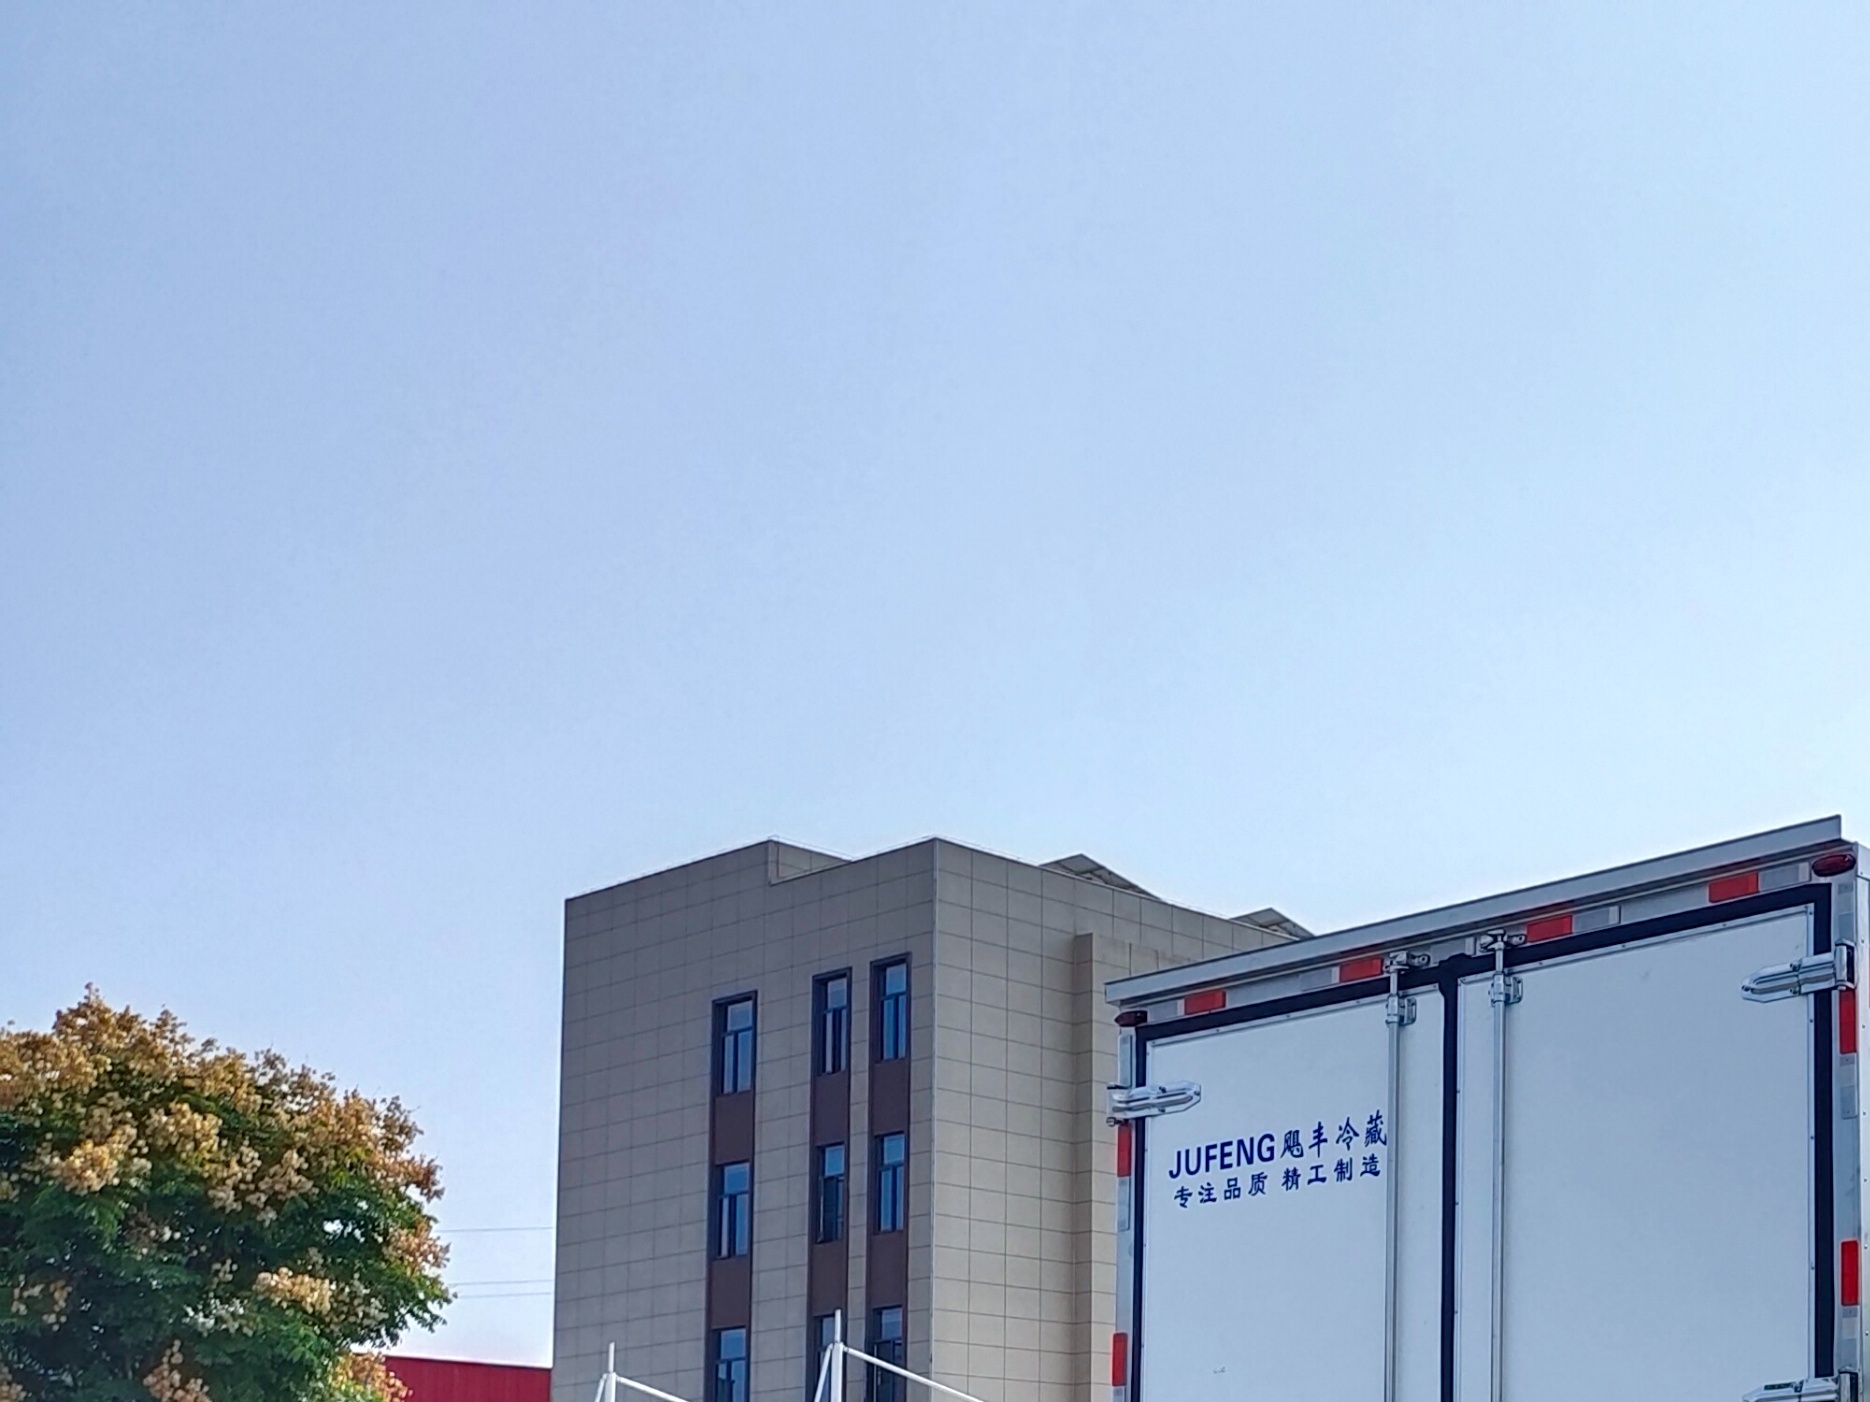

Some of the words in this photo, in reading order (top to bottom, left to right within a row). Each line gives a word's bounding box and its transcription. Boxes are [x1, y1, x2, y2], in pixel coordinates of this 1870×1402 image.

[1173, 1171, 1268, 1209] 专注品质
[1281, 1152, 1381, 1192] 精工制造
